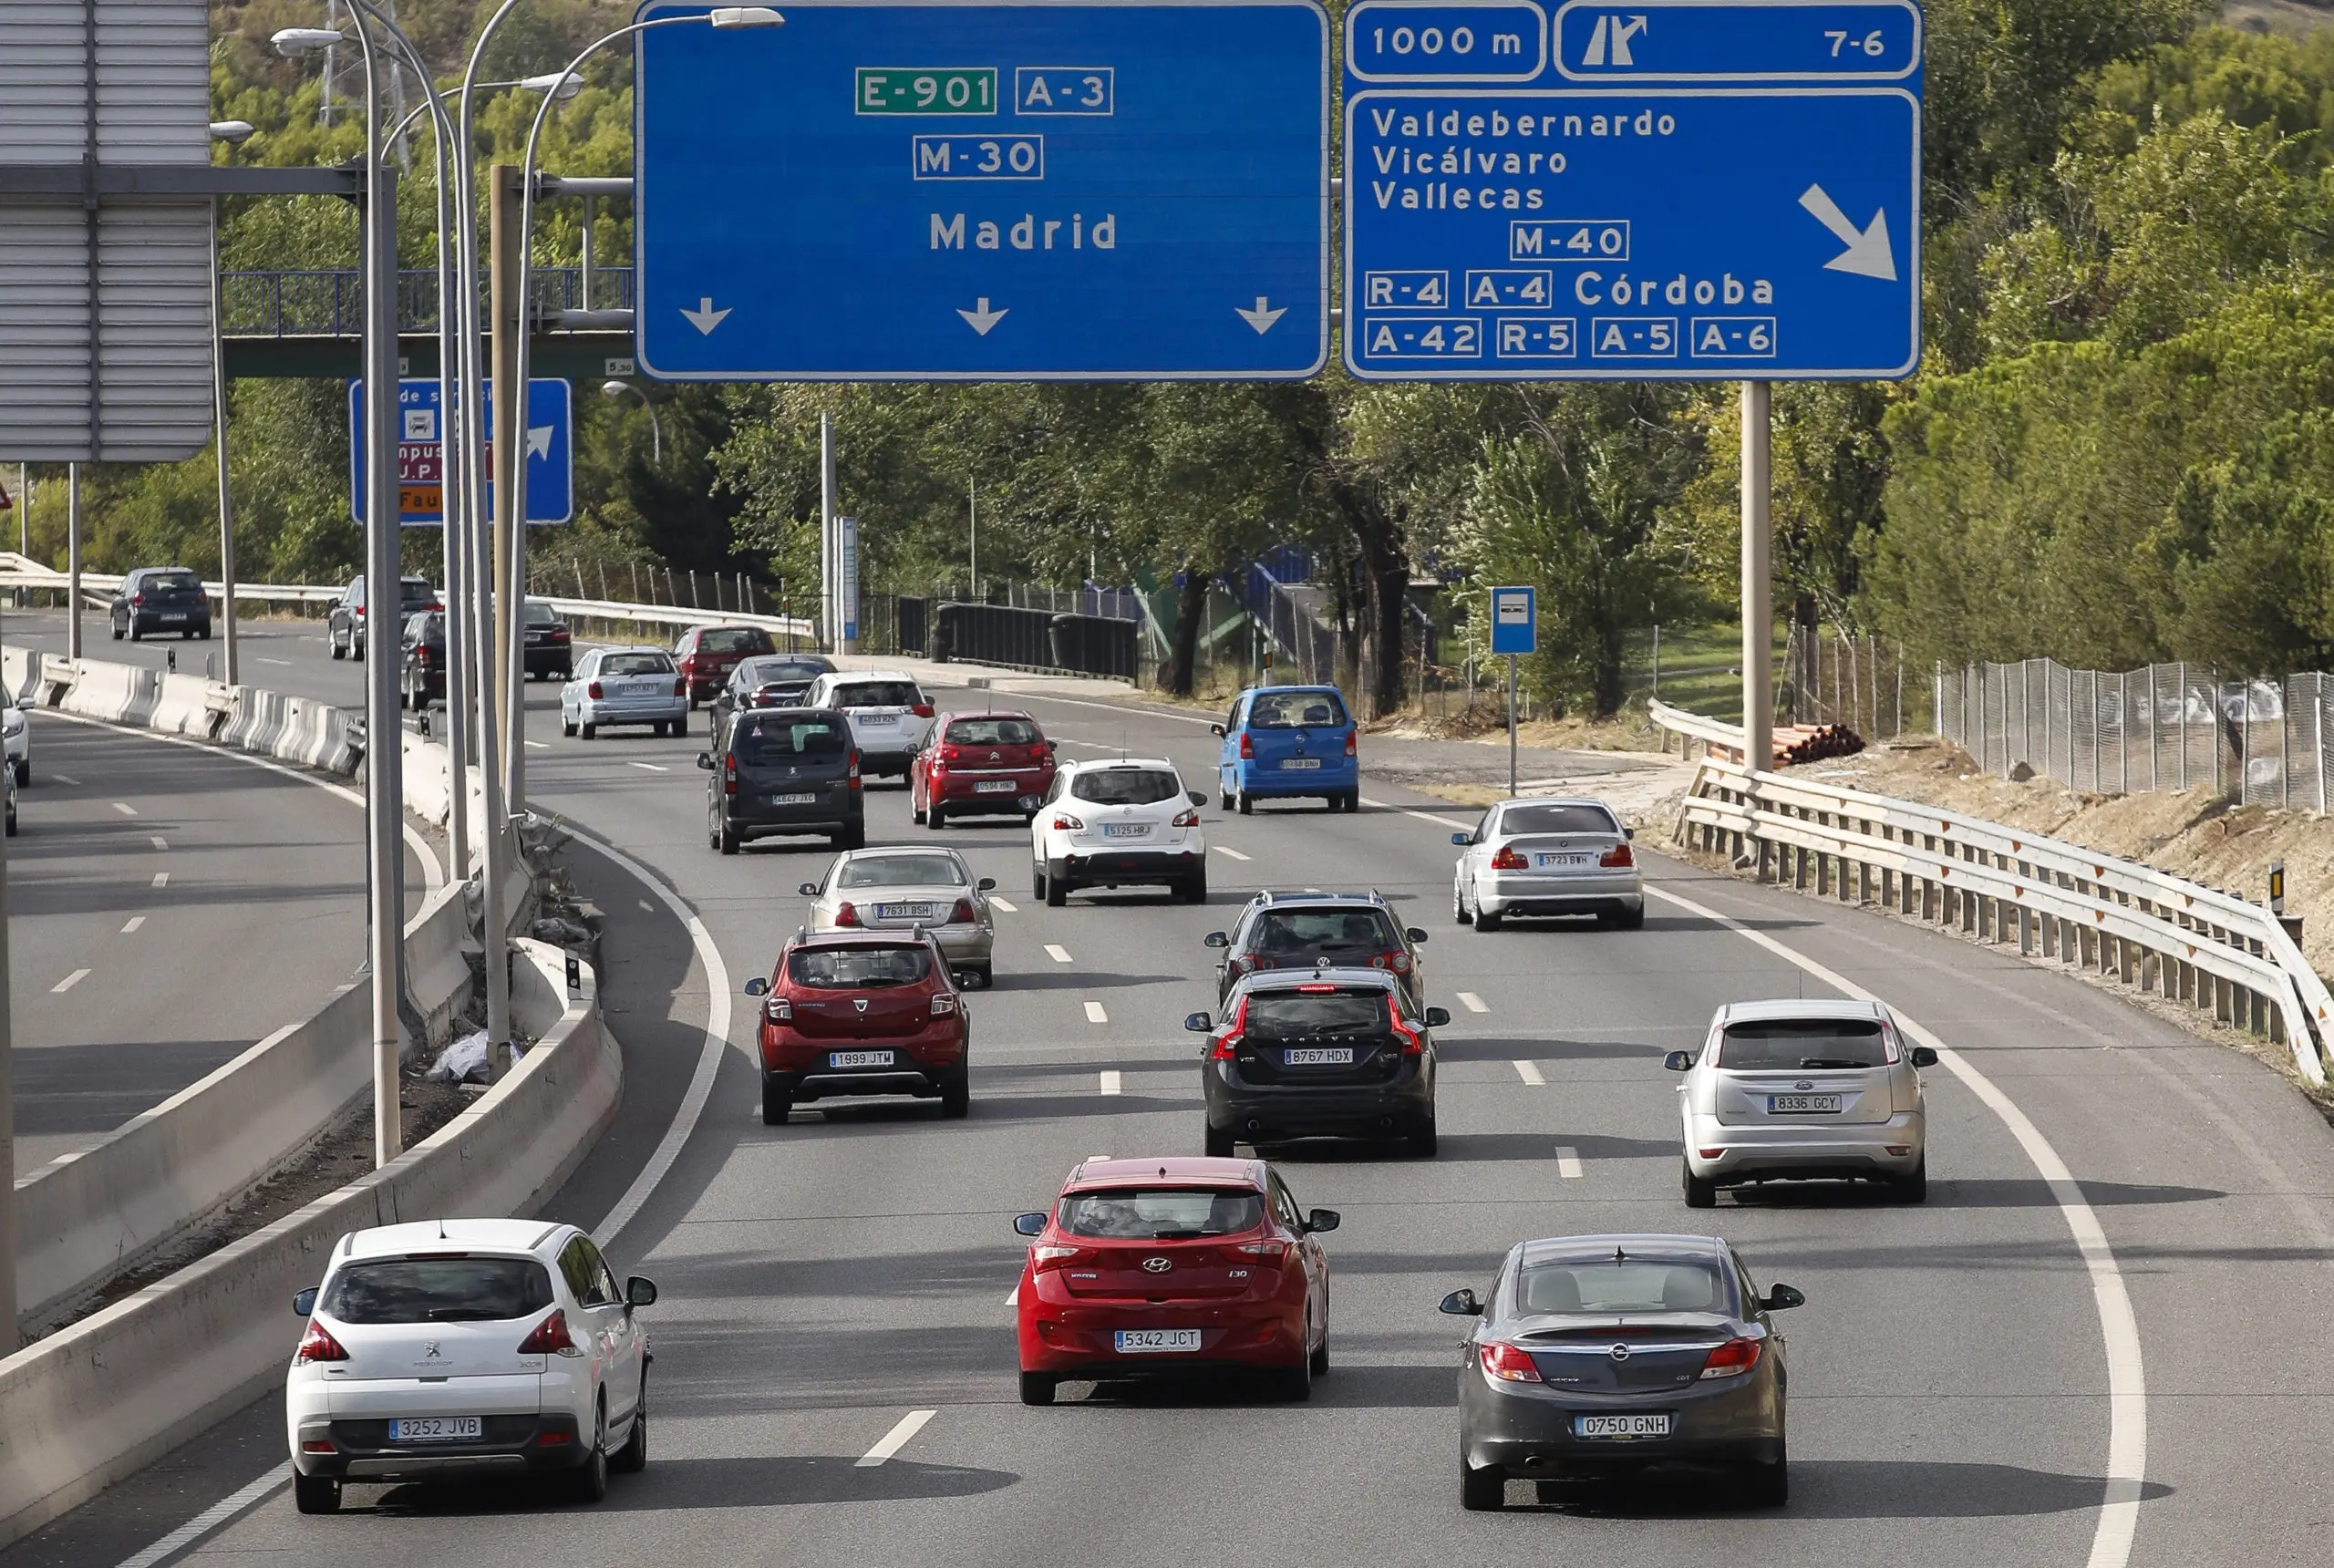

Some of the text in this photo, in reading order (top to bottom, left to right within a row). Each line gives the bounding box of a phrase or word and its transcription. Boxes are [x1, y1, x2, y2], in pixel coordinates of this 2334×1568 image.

[1374, 27, 1521, 54] 1000 m
[1824, 30, 1885, 57] 7-6
[864, 77, 1104, 107] E-901 A-3
[1372, 108, 1676, 137] Valdebernardo
[921, 142, 1036, 172] M-30
[1373, 146, 1566, 175] Vicálvaro
[1372, 181, 1544, 210] Vallecas
[931, 213, 1116, 250] Madrid
[1517, 228, 1622, 254] M-40
[1371, 272, 1773, 305] R-4 A-4 Córdoba
[1372, 325, 1770, 352] A-42 R-5 A-5 A-6
[400, 388, 419, 402] de
[1110, 825, 1151, 835] 5125 HRJ
[1545, 855, 1568, 865] 3723
[885, 906, 907, 916] 7631
[839, 1052, 891, 1065] 1999 JTM
[1293, 1049, 1350, 1062] 8767 HDX
[1779, 1097, 1836, 1109] 8336 GCY
[1125, 1331, 1197, 1346] 5342 JCT
[402, 1418, 477, 1436] 3252 JVB
[1586, 1417, 1666, 1434] 0750 GNH
